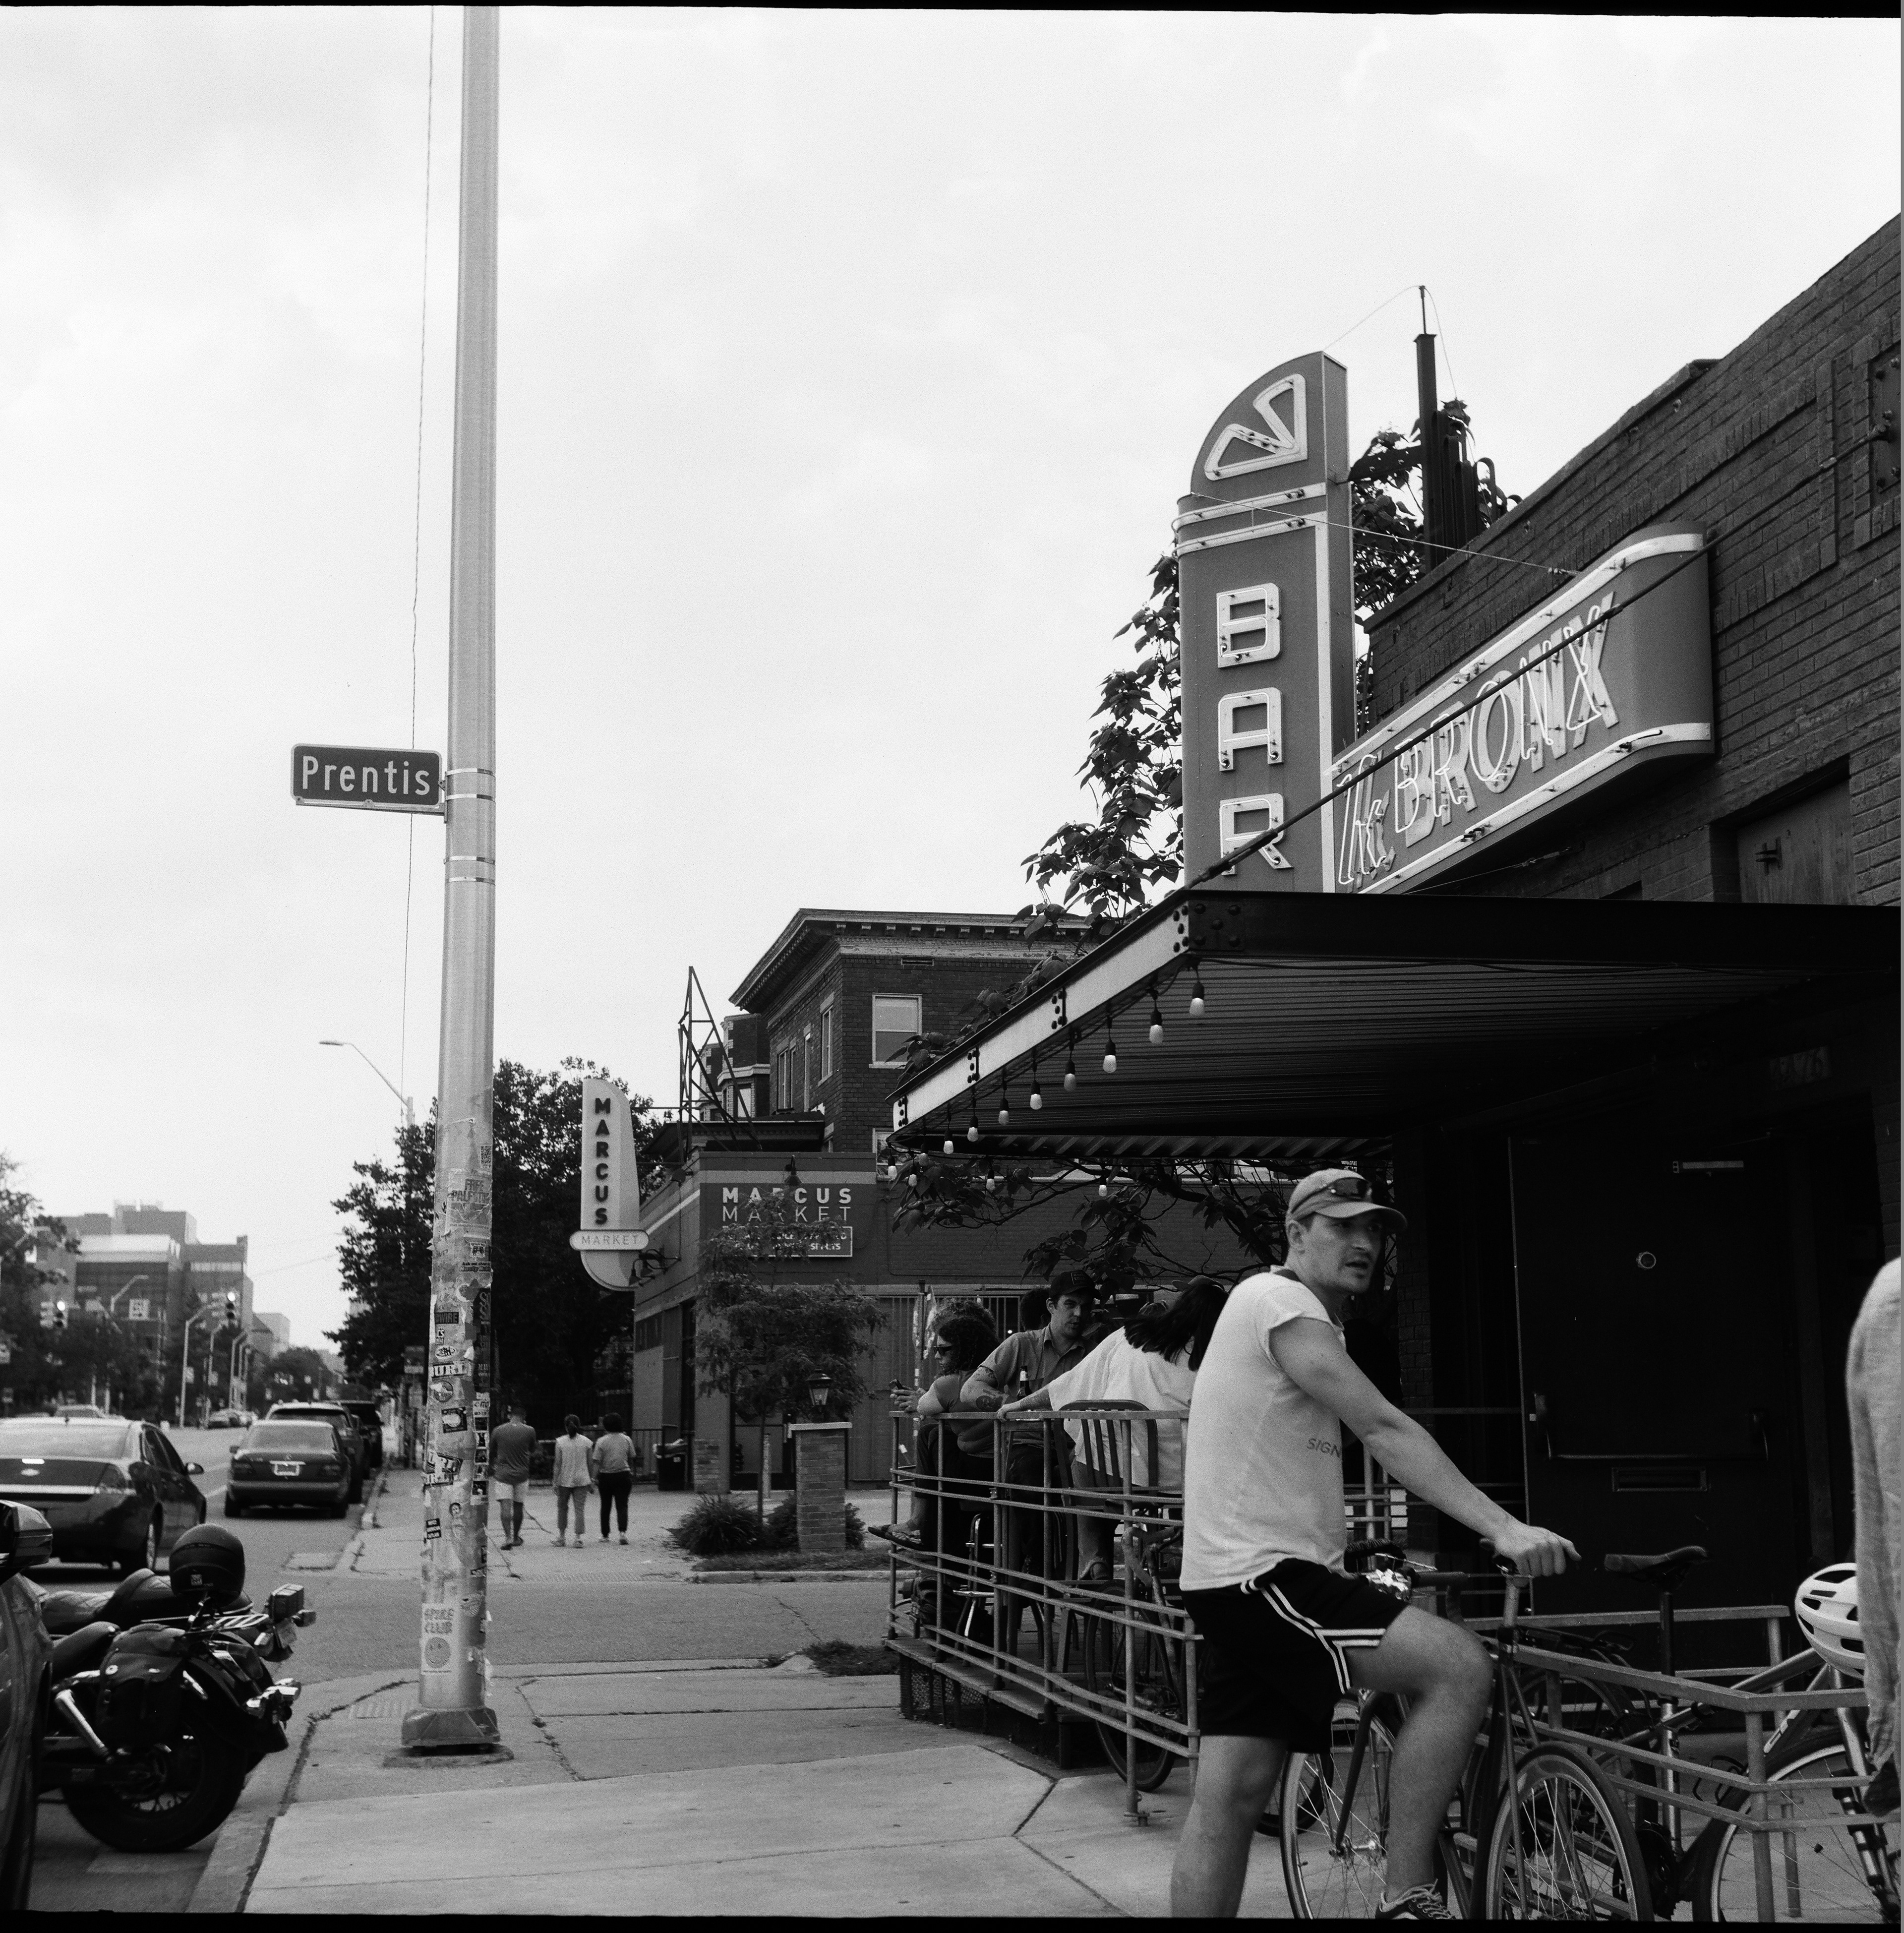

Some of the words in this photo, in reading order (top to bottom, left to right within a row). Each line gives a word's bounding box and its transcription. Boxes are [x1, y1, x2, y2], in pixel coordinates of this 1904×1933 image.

[302, 755, 430, 795] Prentis
[1216, 583, 1293, 876] BAR
[1394, 592, 1619, 847] BRONX
[595, 1098, 610, 1225] MARCUS
[581, 1235, 638, 1245] MARKET
